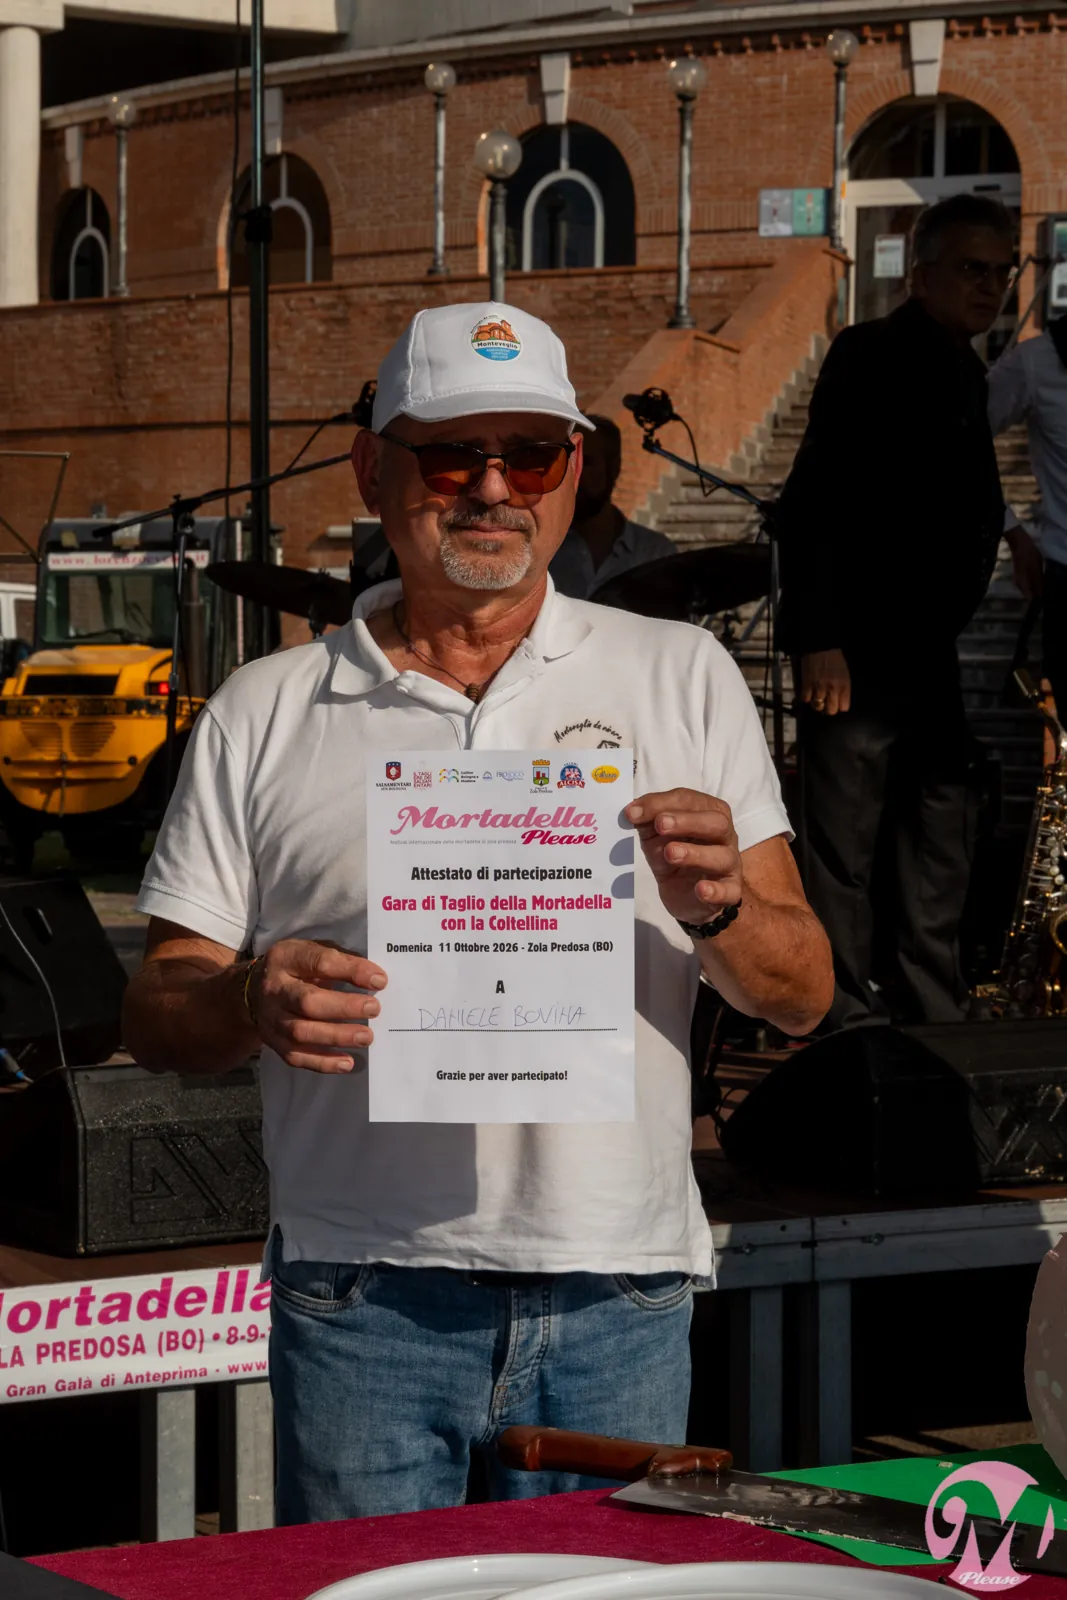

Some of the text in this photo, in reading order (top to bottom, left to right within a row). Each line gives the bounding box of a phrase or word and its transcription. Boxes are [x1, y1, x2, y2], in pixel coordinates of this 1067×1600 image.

[477, 341, 518, 349] Monteveglio
[521, 829, 597, 845] Please
[411, 866, 592, 881] Attestato di partecipazione
[382, 894, 612, 912] Gara di Taglio della Mortadella
[441, 915, 558, 931] con la Coltellina
[386, 943, 432, 953] Domenica
[439, 942, 451, 952] 11
[454, 942, 490, 952] Ottobre
[492, 942, 519, 952] 2026
[527, 942, 548, 952] Zola
[551, 941, 589, 952] Predosa
[592, 941, 614, 952] (BO)
[495, 980, 505, 993] A
[436, 1070, 568, 1082] Grazie per aver partecipato!
[0, 1269, 271, 1334] ortadella
[36, 1333, 146, 1365] PREDOSA
[158, 1328, 204, 1357] (BO)
[226, 1324, 272, 1346] 8-9-
[6, 1384, 46, 1398] Gran
[55, 1376, 92, 1392] Galà
[100, 1374, 116, 1388] di
[123, 1366, 208, 1386] Anteprima
